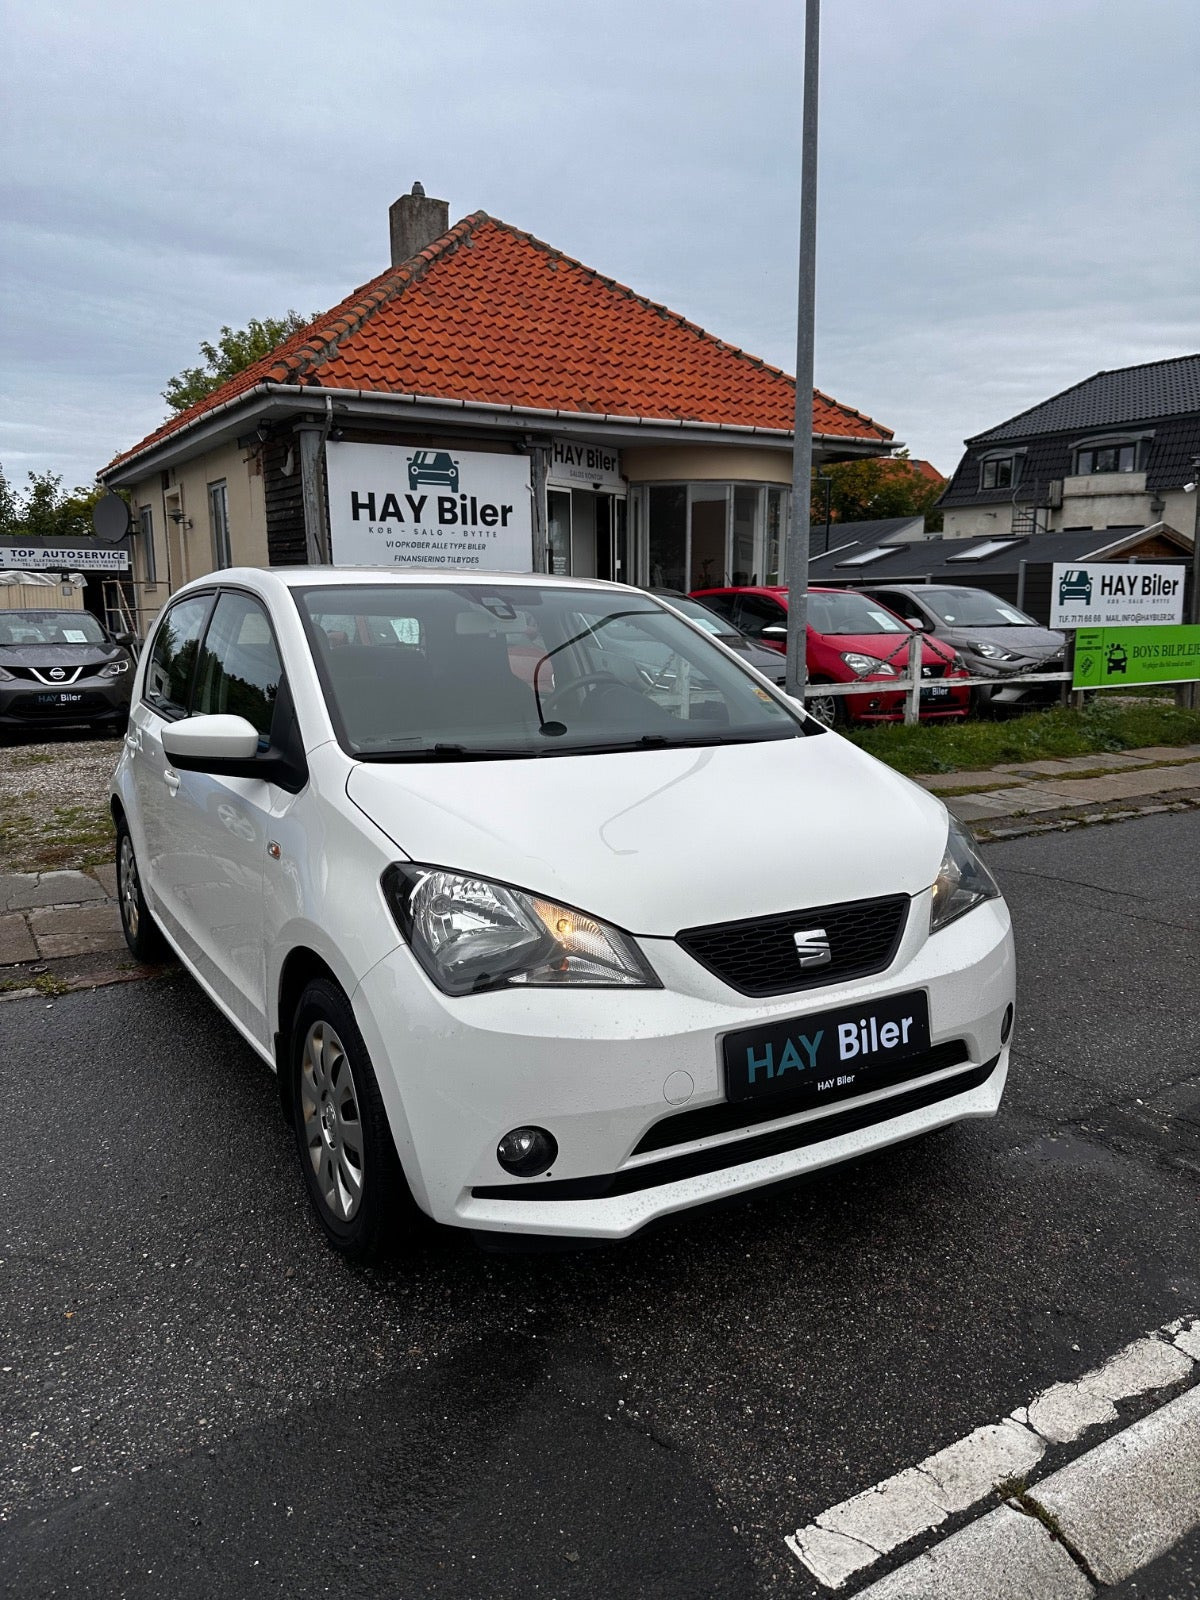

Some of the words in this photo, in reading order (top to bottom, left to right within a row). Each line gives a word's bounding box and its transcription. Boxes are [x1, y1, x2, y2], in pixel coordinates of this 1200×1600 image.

[554, 443, 583, 467] HAY
[587, 448, 616, 472] Biler
[350, 491, 428, 524] HAY
[437, 493, 513, 527] Biler
[368, 526, 393, 534] KØB
[414, 528, 443, 536] SALG
[463, 530, 497, 538] BYTTE
[432, 542, 448, 550] ALLE
[449, 542, 467, 550] TYPE
[467, 543, 486, 551] BILER
[10, 549, 35, 557] TOP
[42, 550, 126, 560] AUTOSERVICE
[394, 554, 446, 563] FINANSIERING
[447, 555, 480, 564] TILBYDES
[1100, 575, 1138, 596] HAY
[1141, 573, 1179, 596] Biler
[1132, 645, 1160, 659] BOYS
[38, 694, 58, 703] HAY
[60, 693, 82, 702] Biler
[932, 687, 948, 696] Biler
[746, 1030, 825, 1084] HAY
[837, 1016, 913, 1061] Biler
[817, 1078, 835, 1092] HAY
[836, 1073, 856, 1087] Biler
